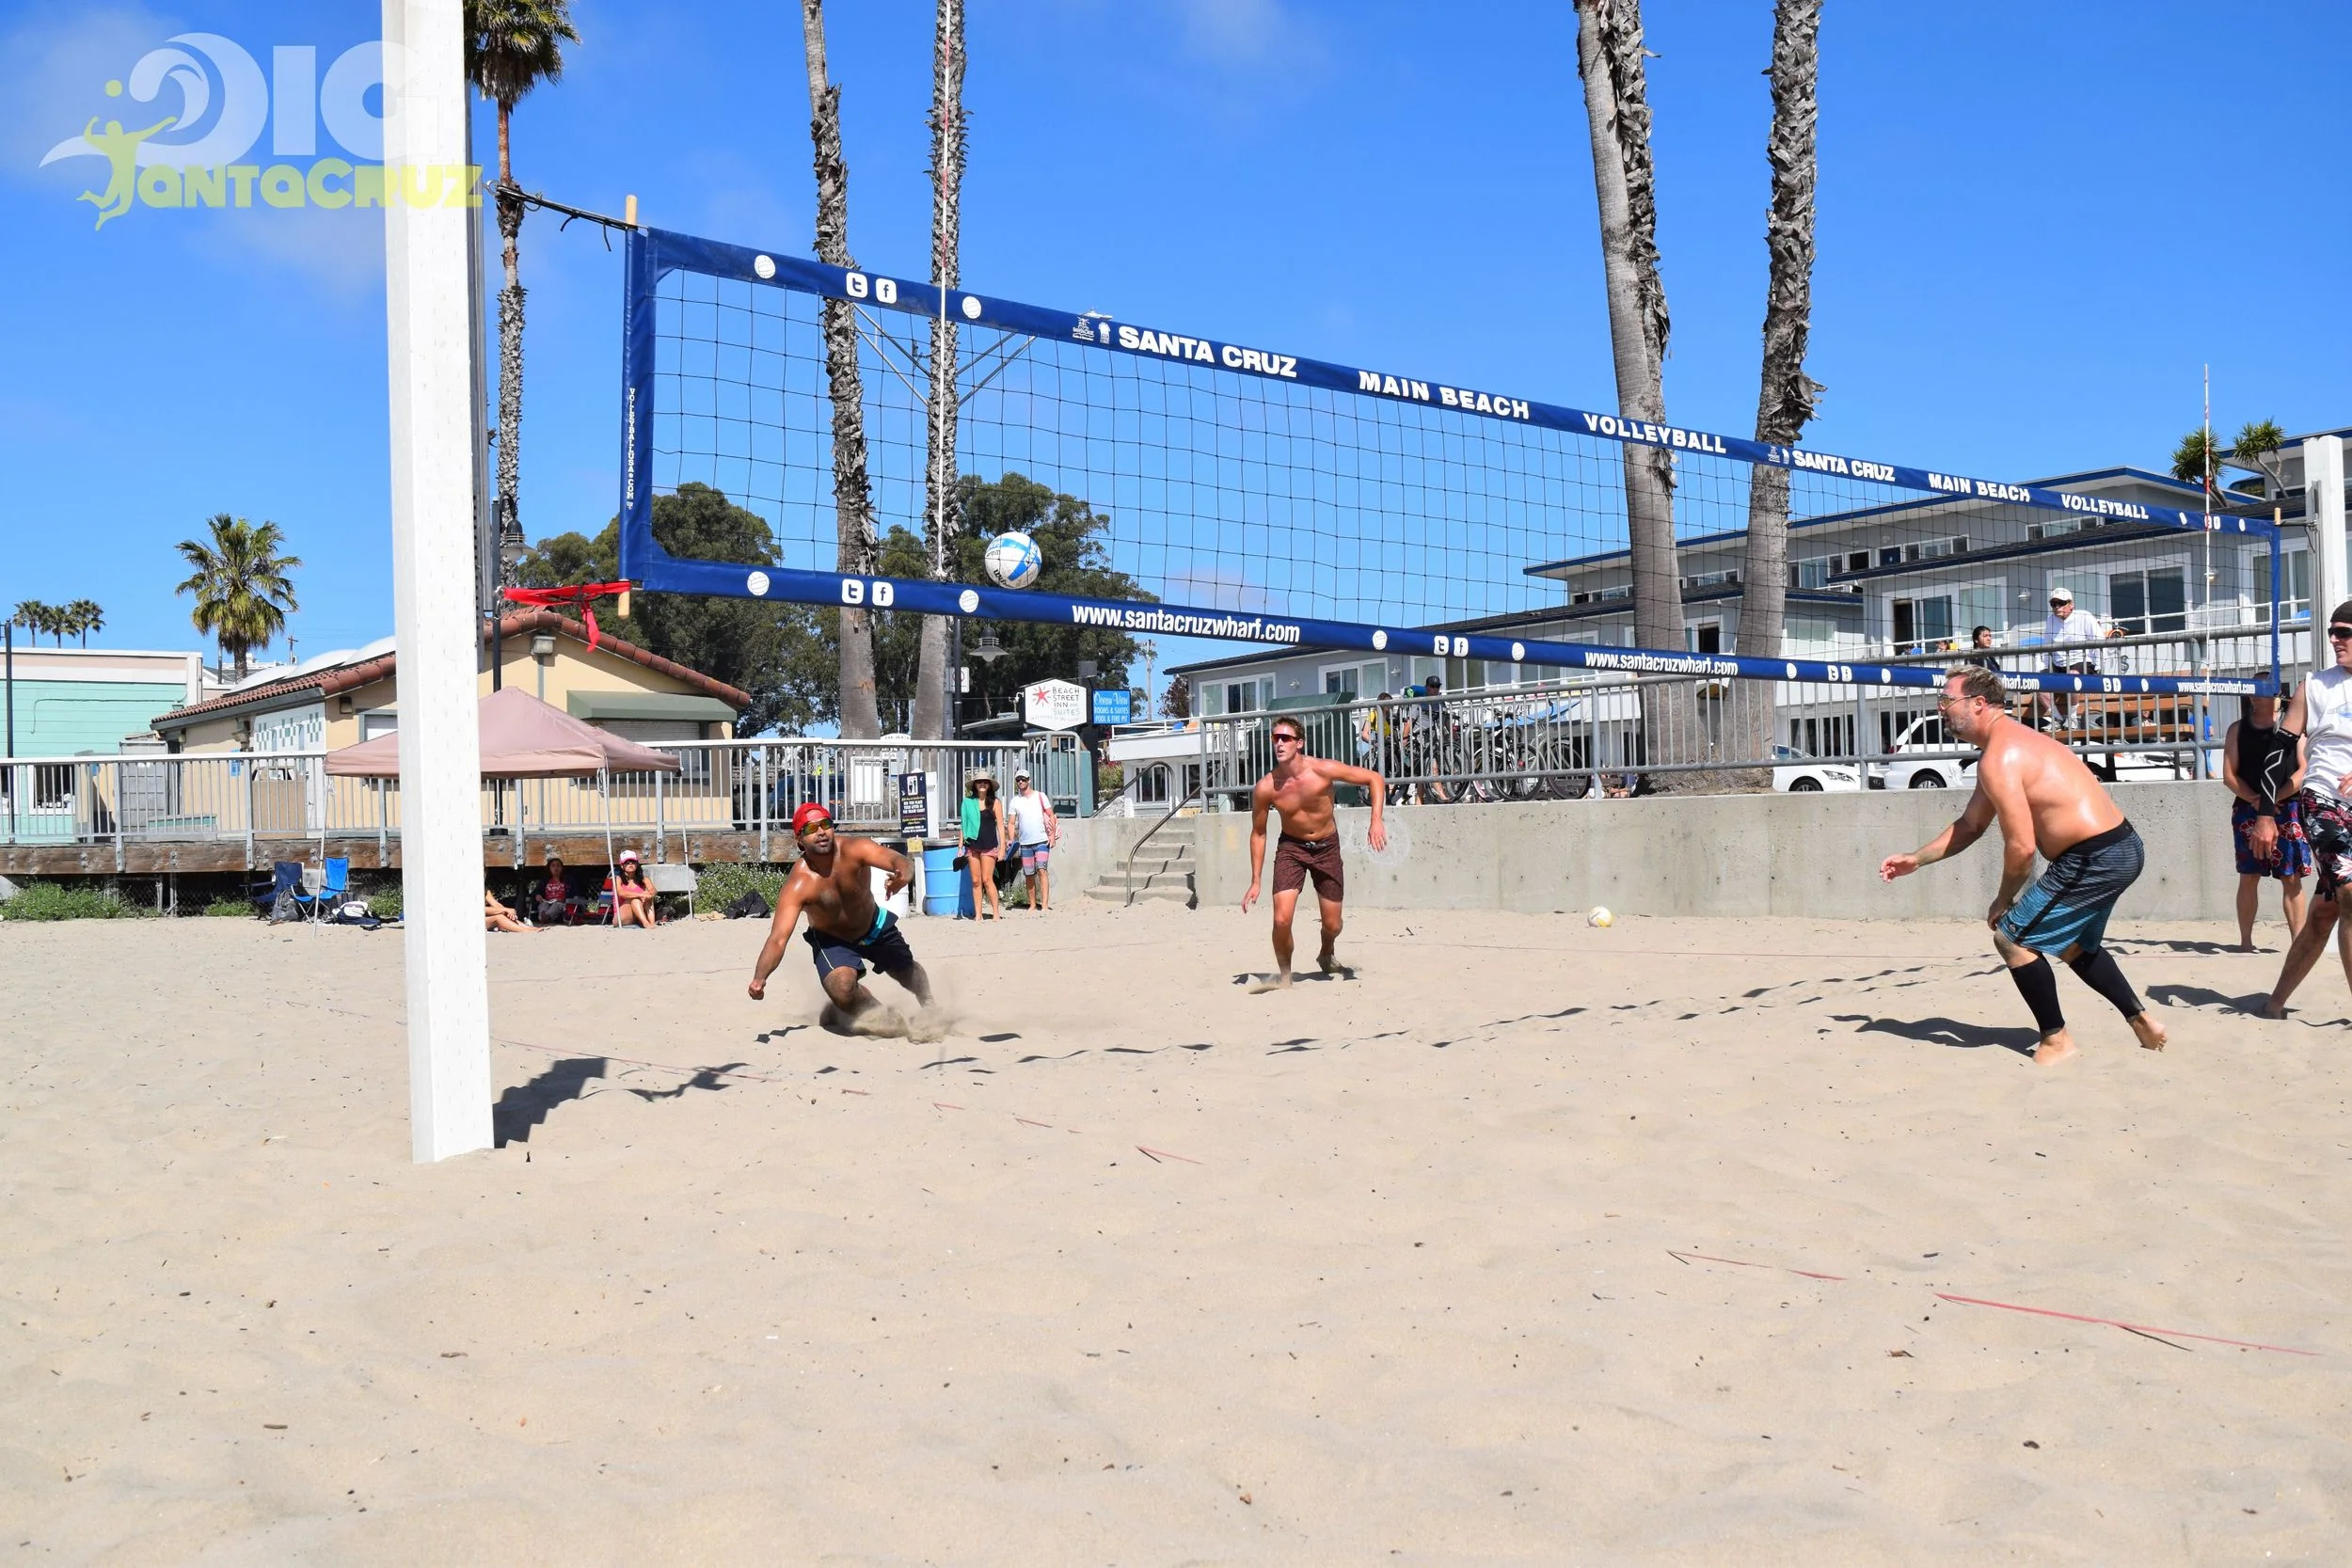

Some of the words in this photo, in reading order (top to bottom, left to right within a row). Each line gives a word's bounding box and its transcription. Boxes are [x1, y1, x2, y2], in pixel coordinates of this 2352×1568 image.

[1119, 325, 1216, 363] SANTA
[1222, 345, 1297, 378] CRUZ
[1358, 371, 1430, 402] MAIN
[1439, 386, 1530, 420] BEACH
[1582, 412, 1727, 454] VOLLEYBALL
[1792, 450, 1849, 475] SANTA
[1851, 459, 1896, 483] CRUZ
[1929, 473, 1972, 494] MAIN
[1975, 481, 2030, 503] BEACH
[2060, 494, 2149, 520] VOLLEYBALL
[1072, 605, 1301, 643] www.santacruzwharf.com
[1585, 652, 1739, 676] www.santacruzwharf.com
